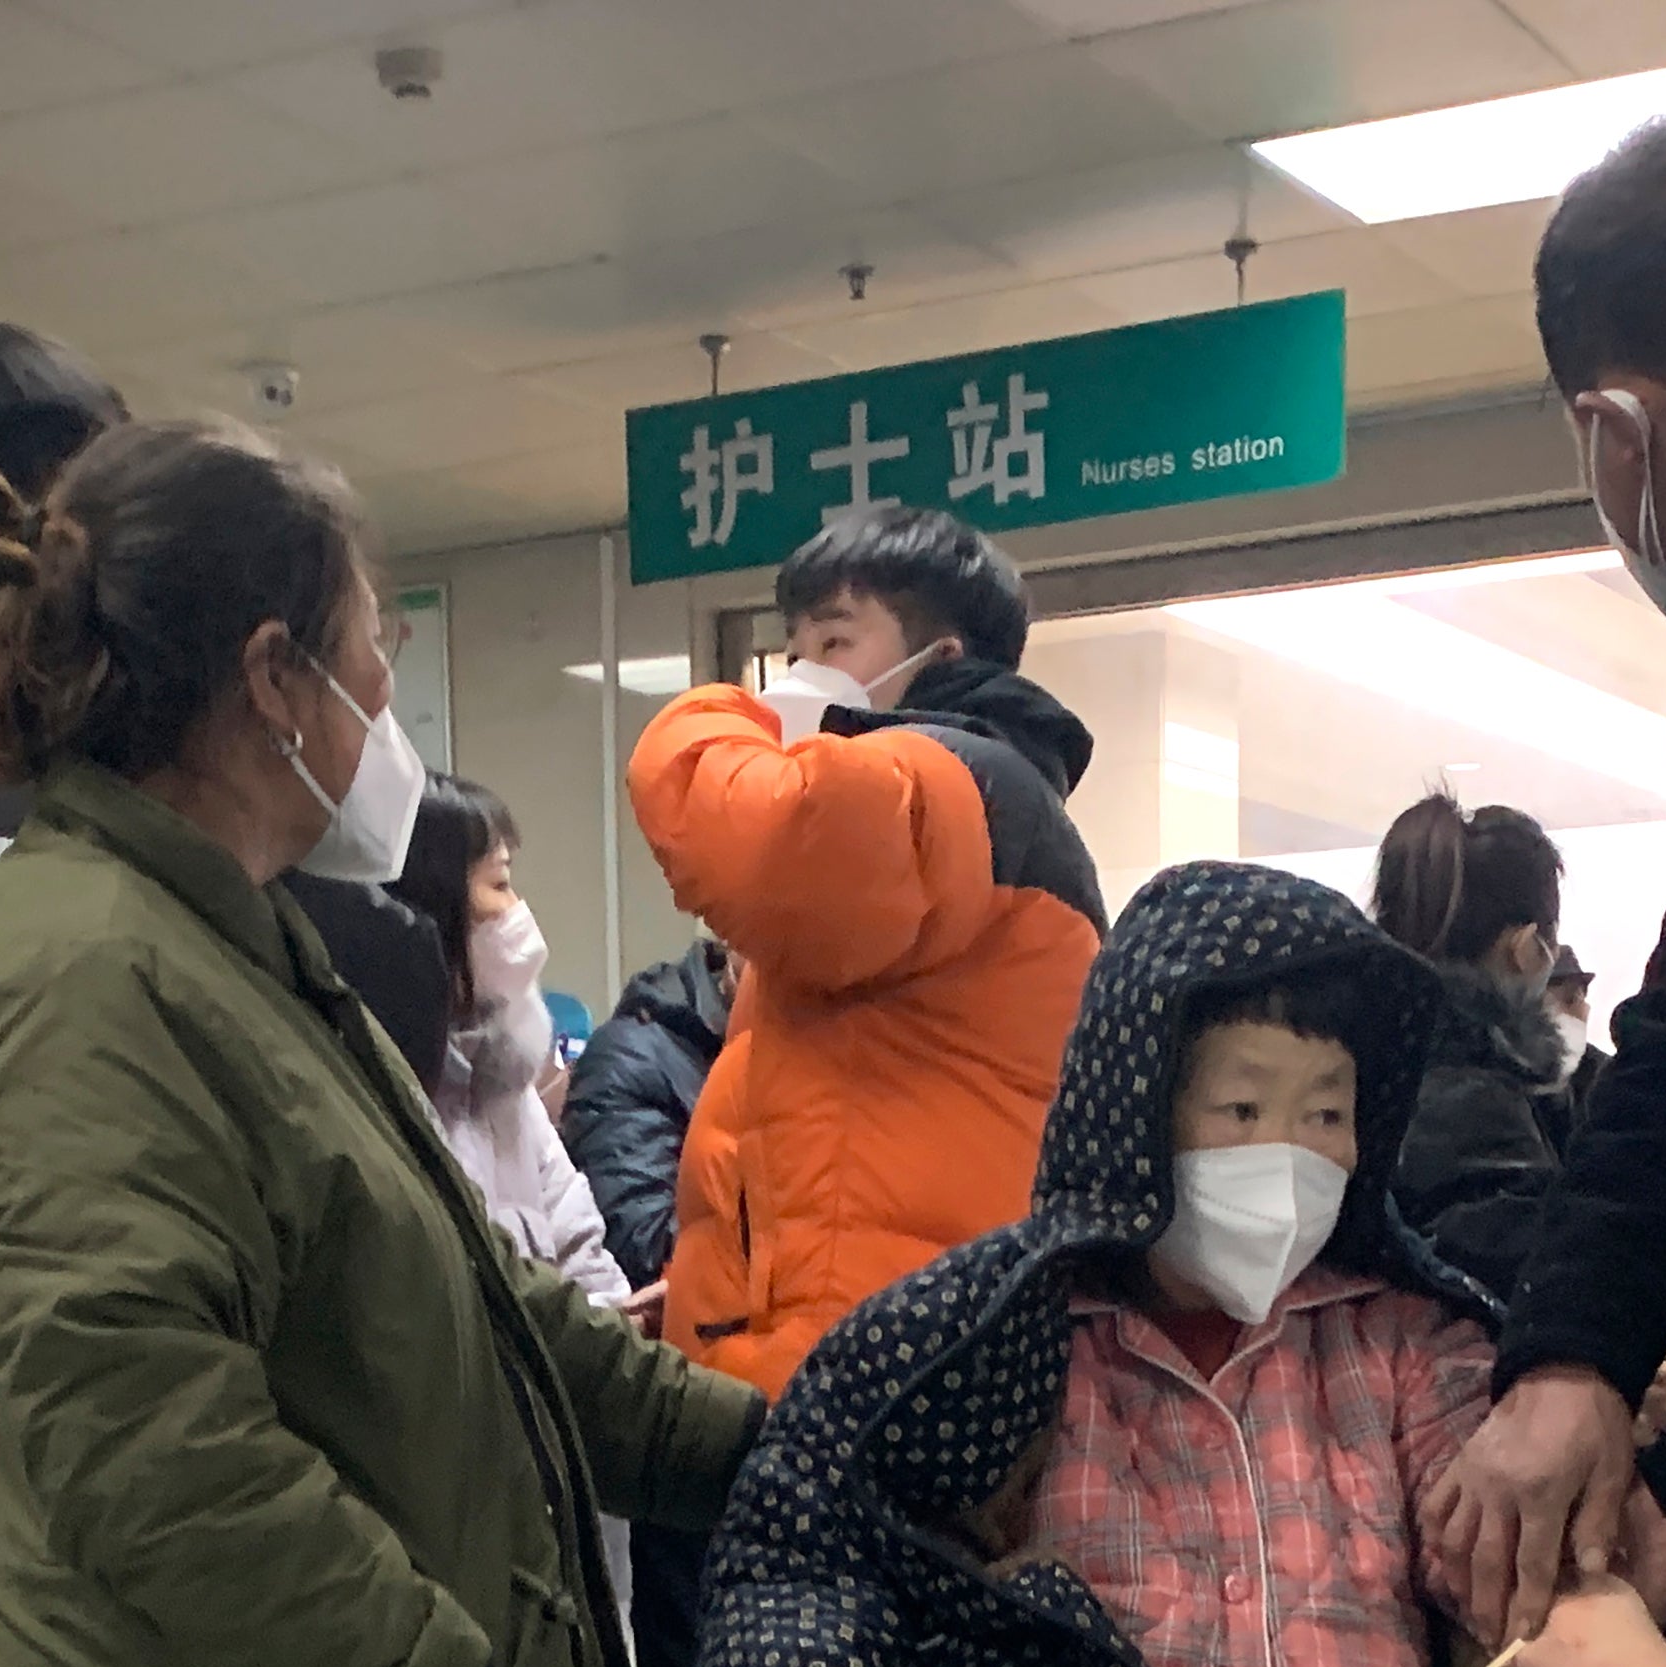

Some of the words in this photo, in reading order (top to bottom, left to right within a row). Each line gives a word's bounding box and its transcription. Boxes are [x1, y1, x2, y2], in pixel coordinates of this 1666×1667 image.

[679, 372, 1050, 548] 护士站
[1081, 453, 1176, 487] Nurses
[1191, 434, 1285, 471] station
